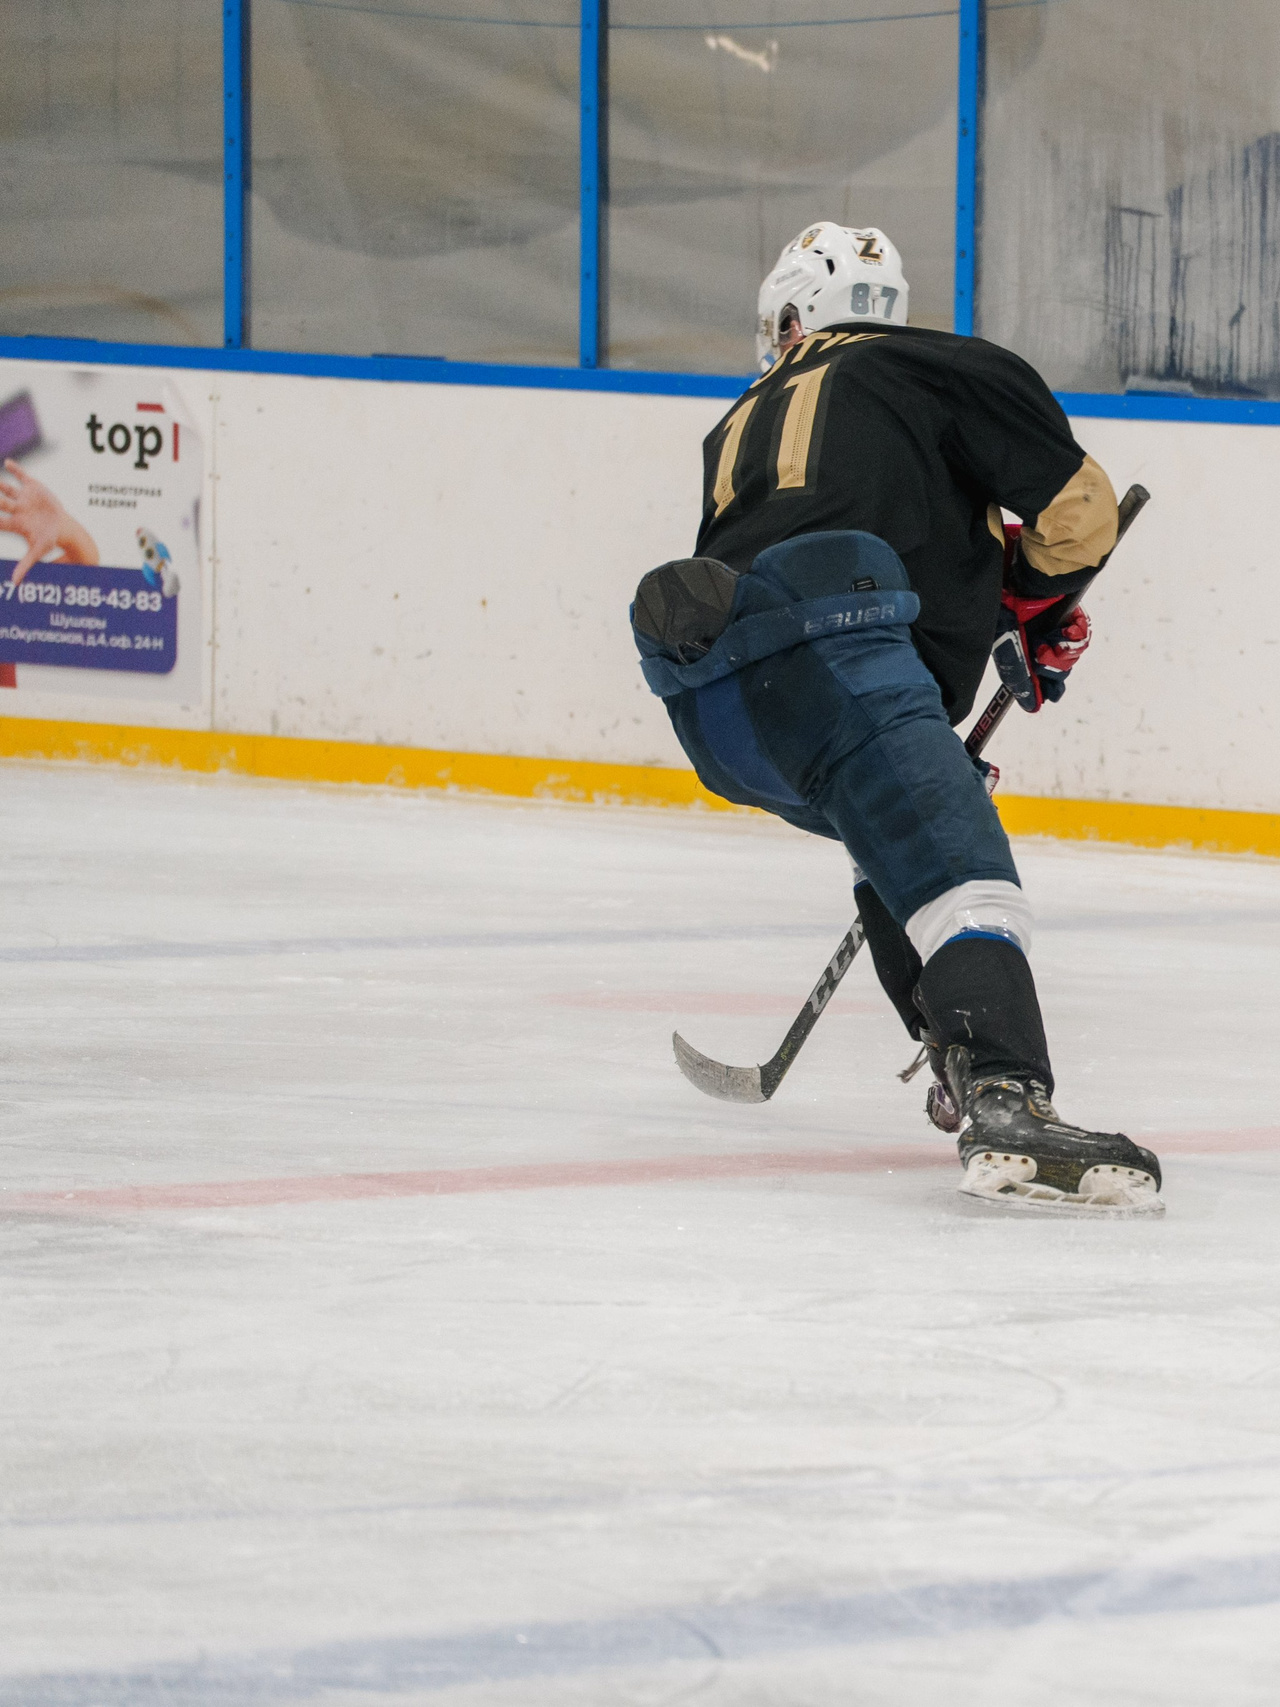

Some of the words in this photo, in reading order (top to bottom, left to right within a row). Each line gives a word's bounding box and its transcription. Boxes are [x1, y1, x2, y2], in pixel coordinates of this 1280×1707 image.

[856, 237, 883, 261] Z
[851, 283, 898, 319] 87
[87, 413, 163, 469] top
[713, 364, 830, 518] 11
[18, 582, 61, 606] (812)
[64, 584, 162, 612] 385-43-83
